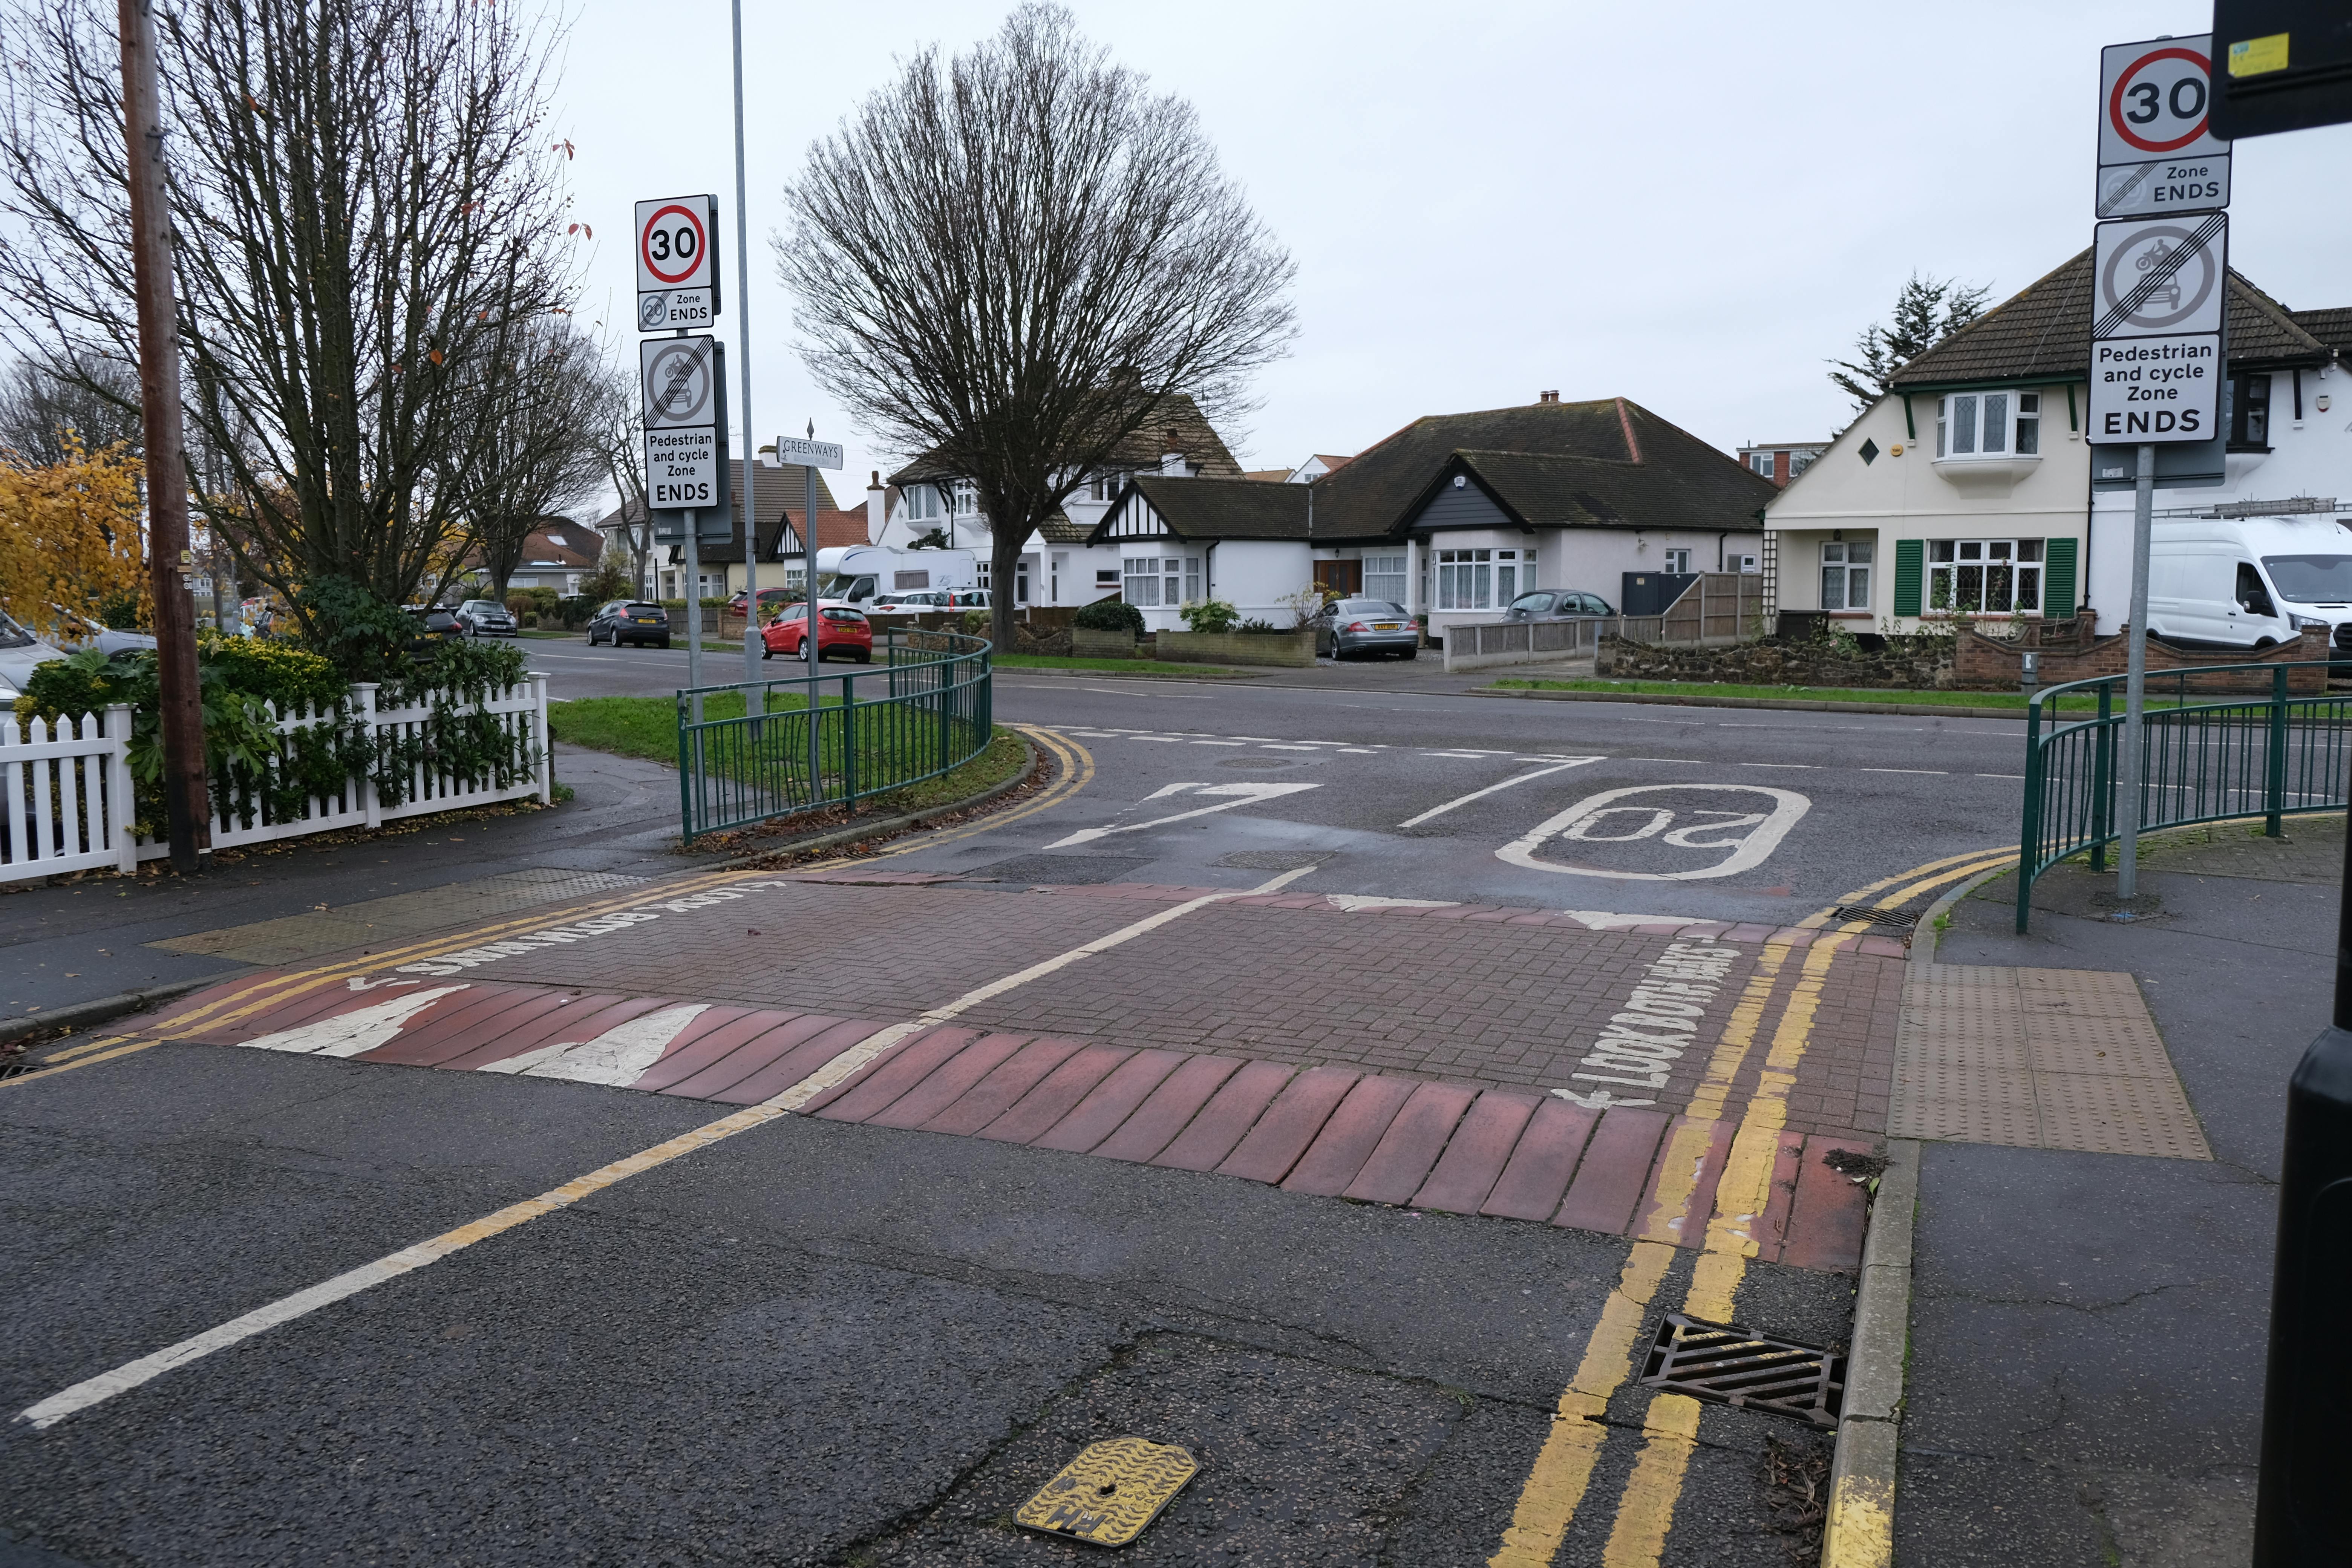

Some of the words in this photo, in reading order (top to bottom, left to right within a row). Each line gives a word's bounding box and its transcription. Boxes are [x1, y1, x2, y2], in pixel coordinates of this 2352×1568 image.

[2126, 77, 2206, 124] 30
[2167, 166, 2208, 179] Zone
[2154, 181, 2219, 202] ENDS
[651, 227, 695, 260] 30
[677, 294, 700, 304] Zone
[671, 306, 707, 321] ENDS
[2099, 343, 2211, 363] Pedestrian
[2104, 367, 2141, 382] and
[2149, 364, 2204, 384] cycle
[2127, 386, 2178, 401] Zone
[2104, 409, 2200, 435] ENDS
[650, 434, 712, 447] Pedestrian
[784, 440, 838, 458] GREENWAYS
[654, 450, 674, 462] and
[679, 449, 709, 462] cycle
[668, 465, 695, 477] Zone
[657, 482, 709, 502] ENDS
[1562, 807, 1769, 848] 20
[632, 887, 765, 913] LOOK
[518, 912, 660, 942] BOTH
[395, 942, 556, 976] WAYS
[1610, 979, 1721, 1032] BOTH
[1571, 1024, 1697, 1089] LOOK
